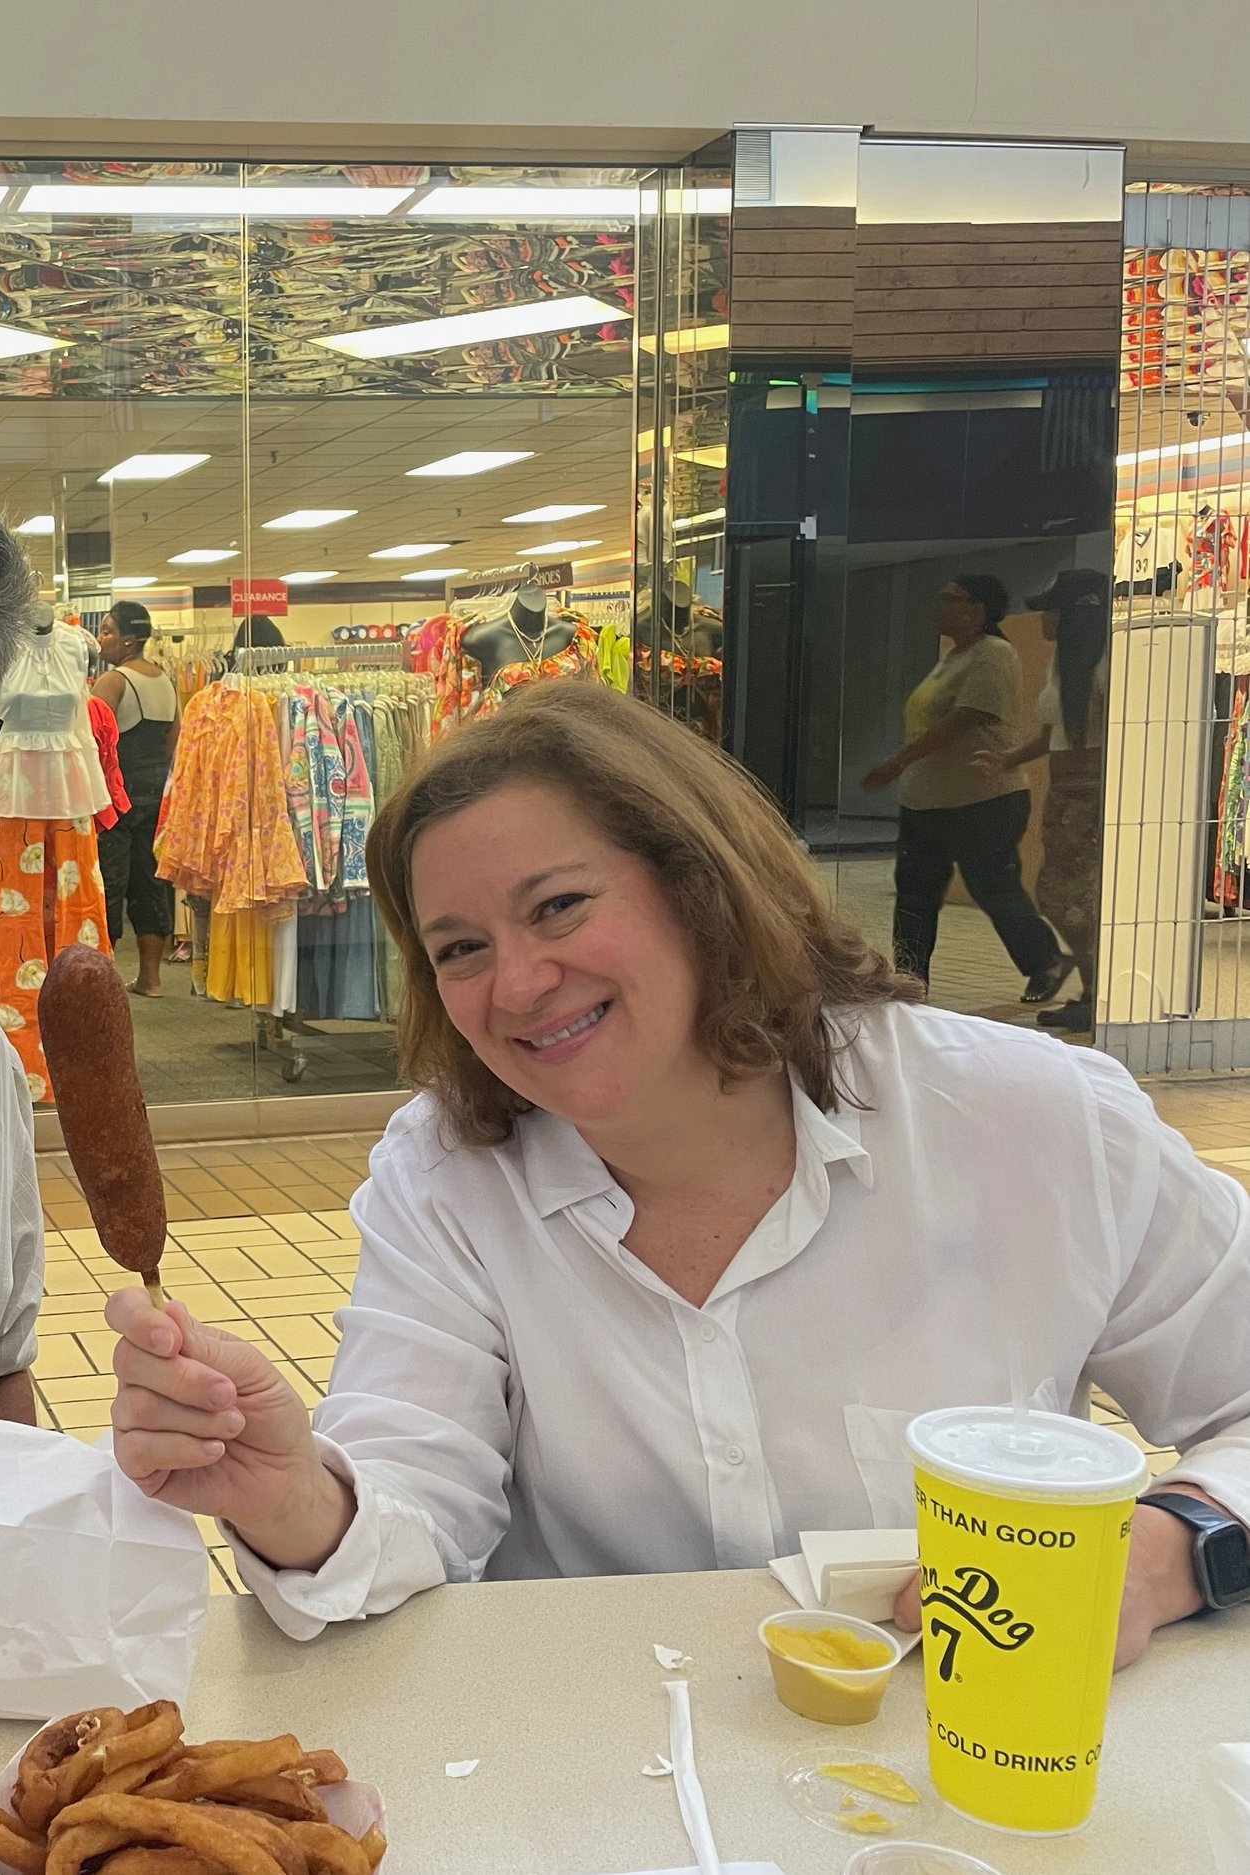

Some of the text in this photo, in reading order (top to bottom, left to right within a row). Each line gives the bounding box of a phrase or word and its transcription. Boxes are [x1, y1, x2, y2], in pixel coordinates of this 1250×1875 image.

[232, 592, 288, 602] CLEARANCE
[930, 1498, 1076, 1549] THAN GOOD
[942, 1566, 1035, 1651] Dog
[930, 1617, 962, 1683] 7
[937, 1723, 987, 1760] COLD
[994, 1750, 1077, 1773] DRINKS
